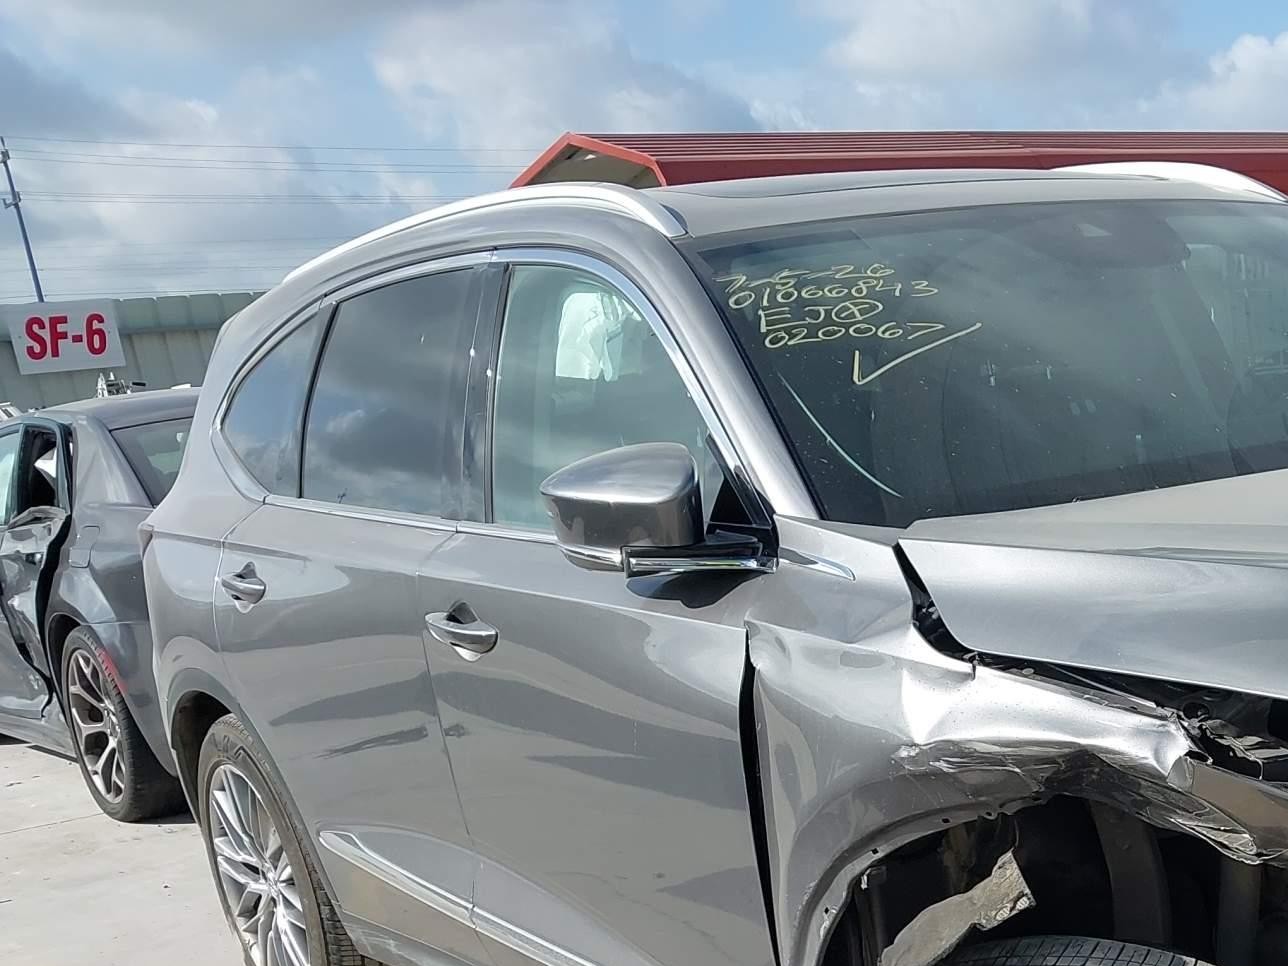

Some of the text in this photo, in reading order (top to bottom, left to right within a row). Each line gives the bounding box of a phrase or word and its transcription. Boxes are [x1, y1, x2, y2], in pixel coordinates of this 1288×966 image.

[712, 264, 895, 293] 7-5-26
[728, 279, 938, 309] 01066843
[24, 312, 107, 361] SF-6
[764, 321, 945, 348] 020067
